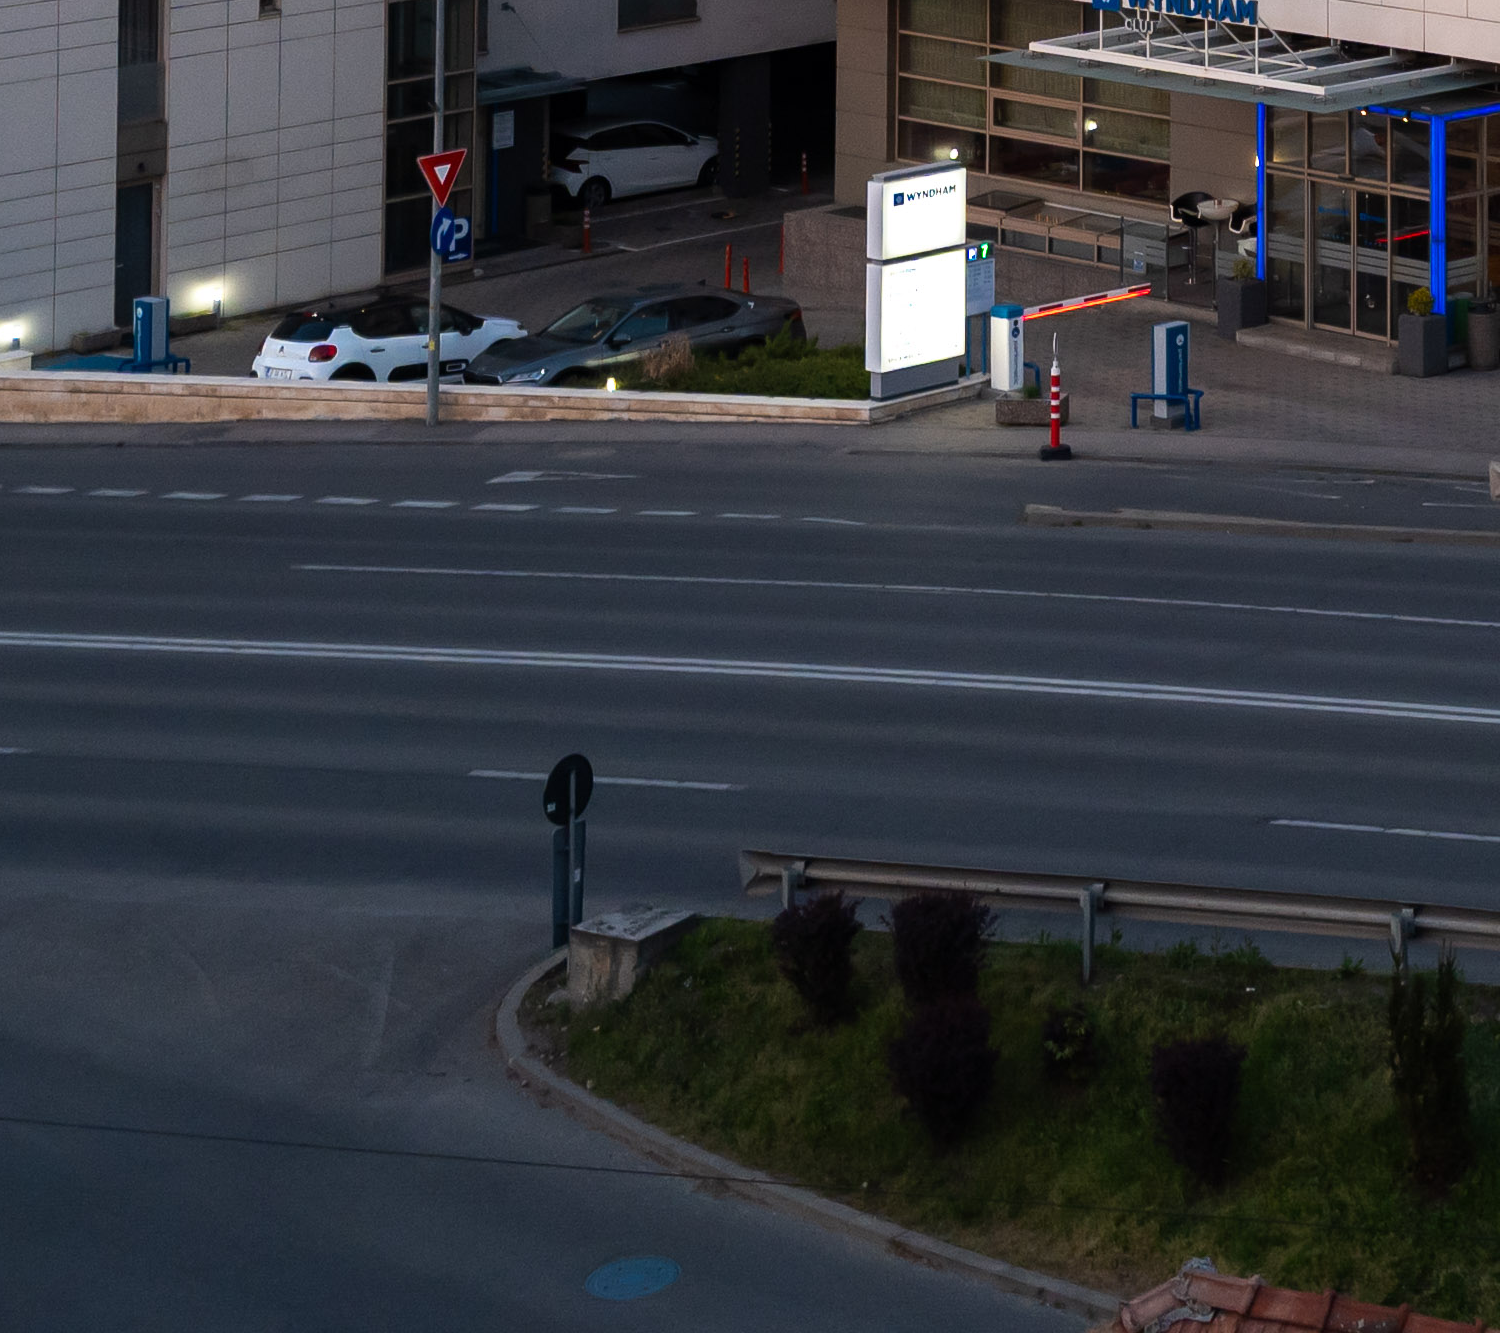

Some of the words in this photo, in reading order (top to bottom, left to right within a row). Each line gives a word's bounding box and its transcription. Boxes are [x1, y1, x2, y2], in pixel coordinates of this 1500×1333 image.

[1125, 18, 1154, 35] CLUJ
[906, 184, 957, 202] WYNDHAM
[449, 217, 469, 252] P
